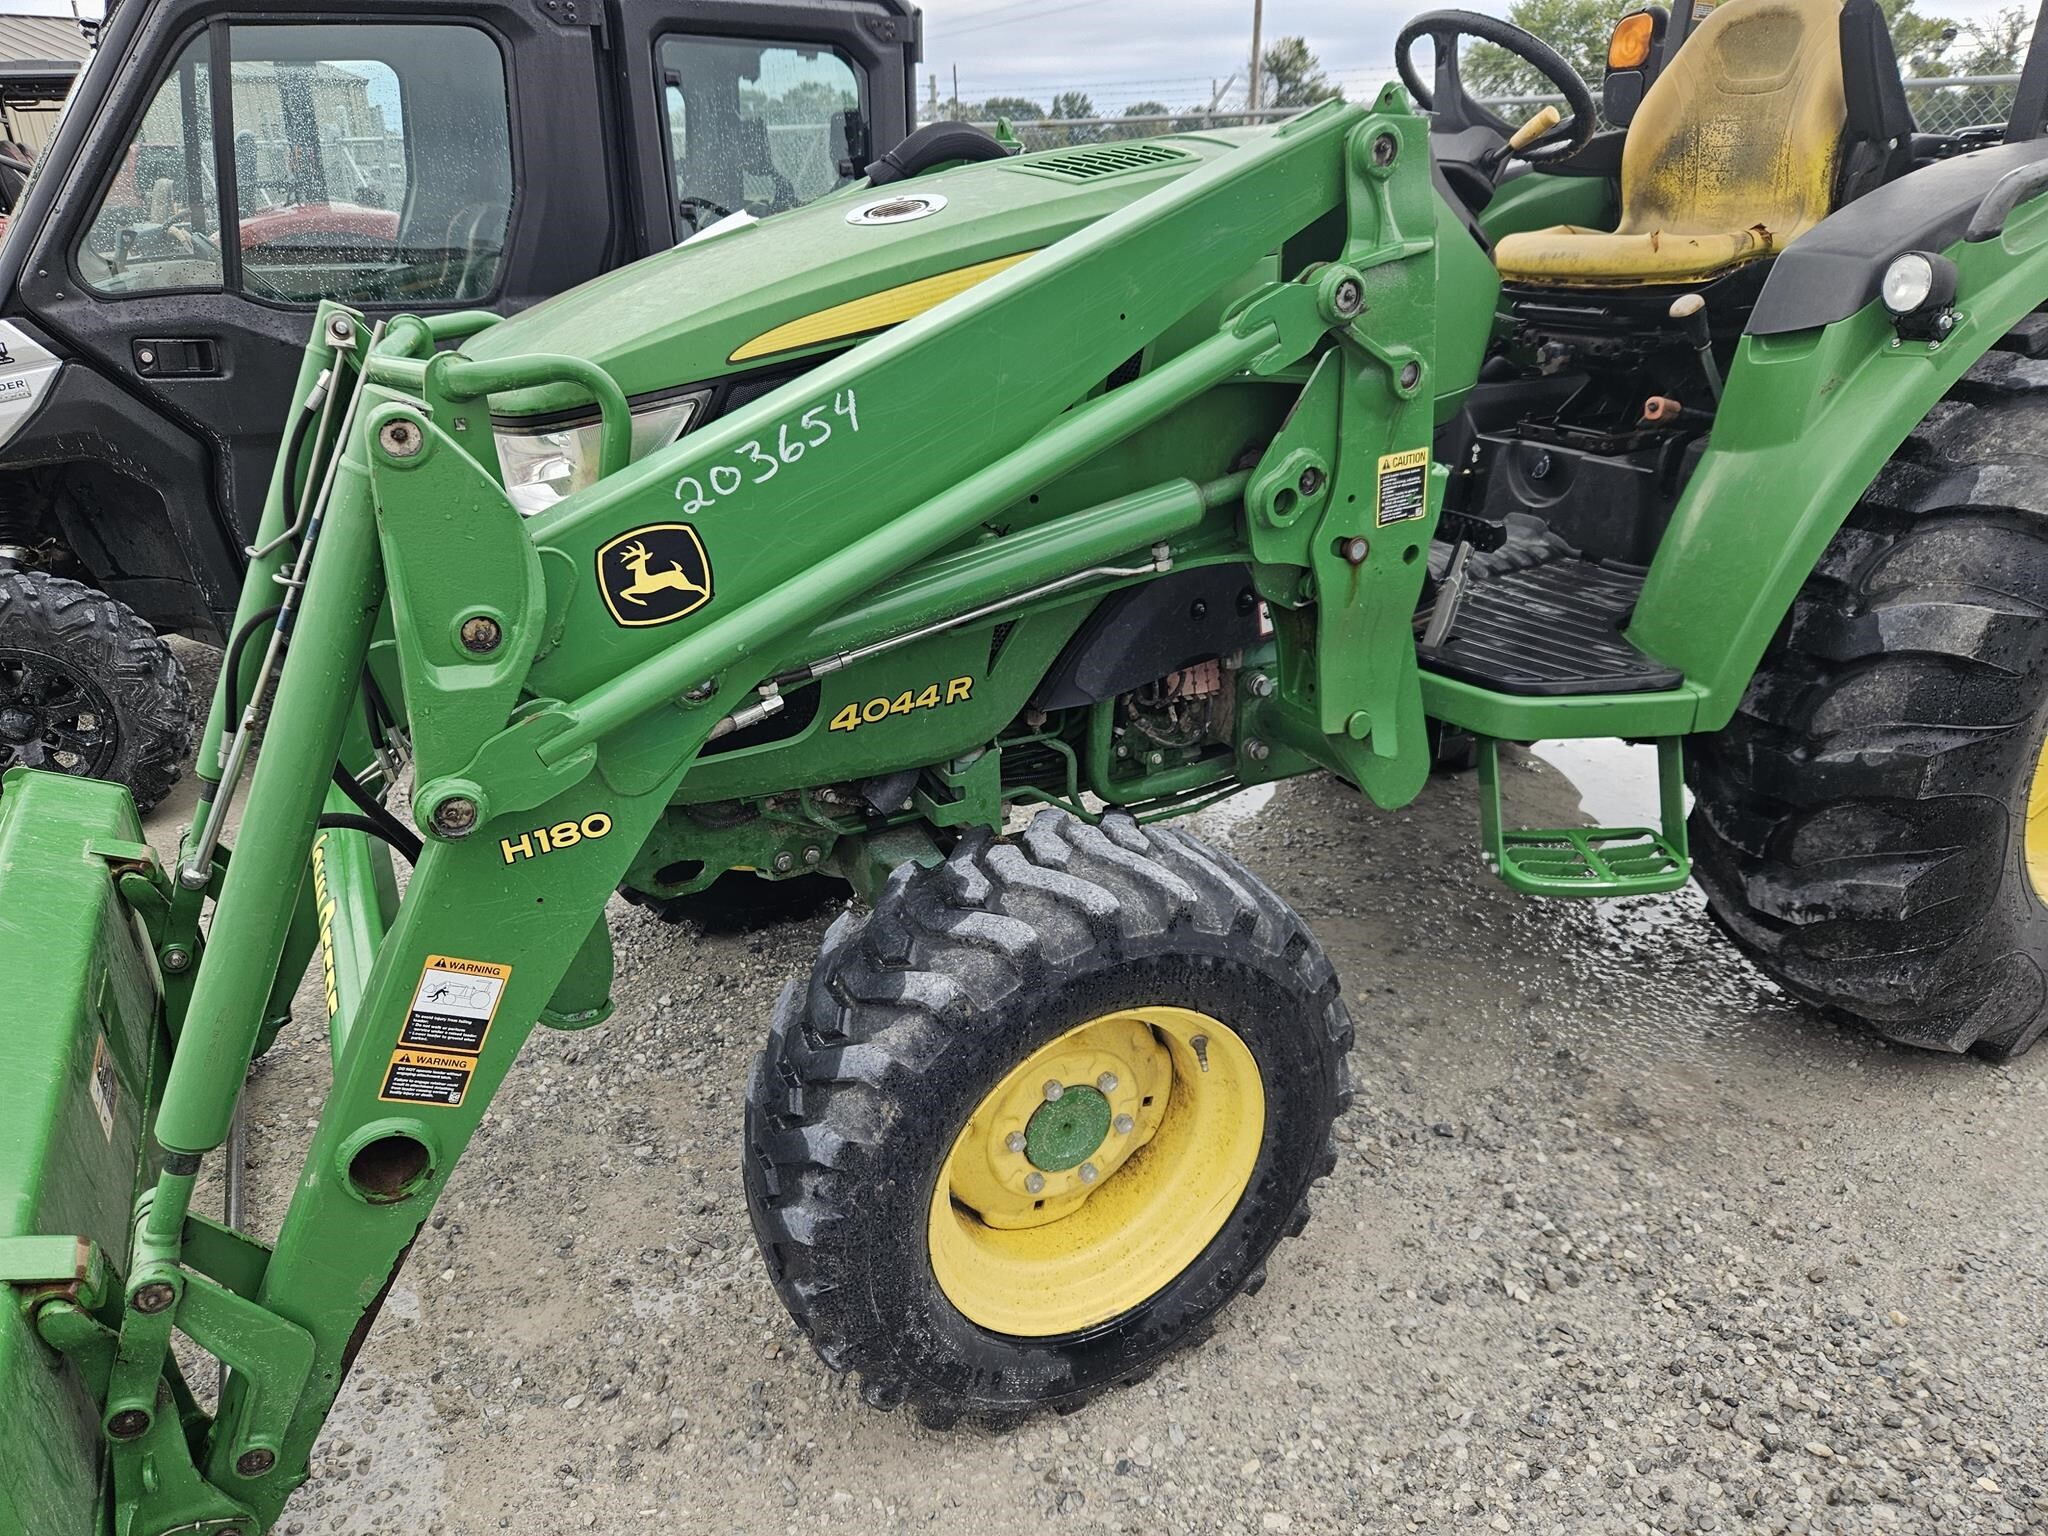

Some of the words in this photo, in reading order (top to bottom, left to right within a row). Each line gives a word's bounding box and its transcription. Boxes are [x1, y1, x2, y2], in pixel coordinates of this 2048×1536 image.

[675, 389, 859, 514] 203654
[1392, 451, 1425, 468] CAUTION
[499, 811, 613, 865] H180
[449, 961, 501, 976] WARNING
[416, 1056, 467, 1068] WARNING
